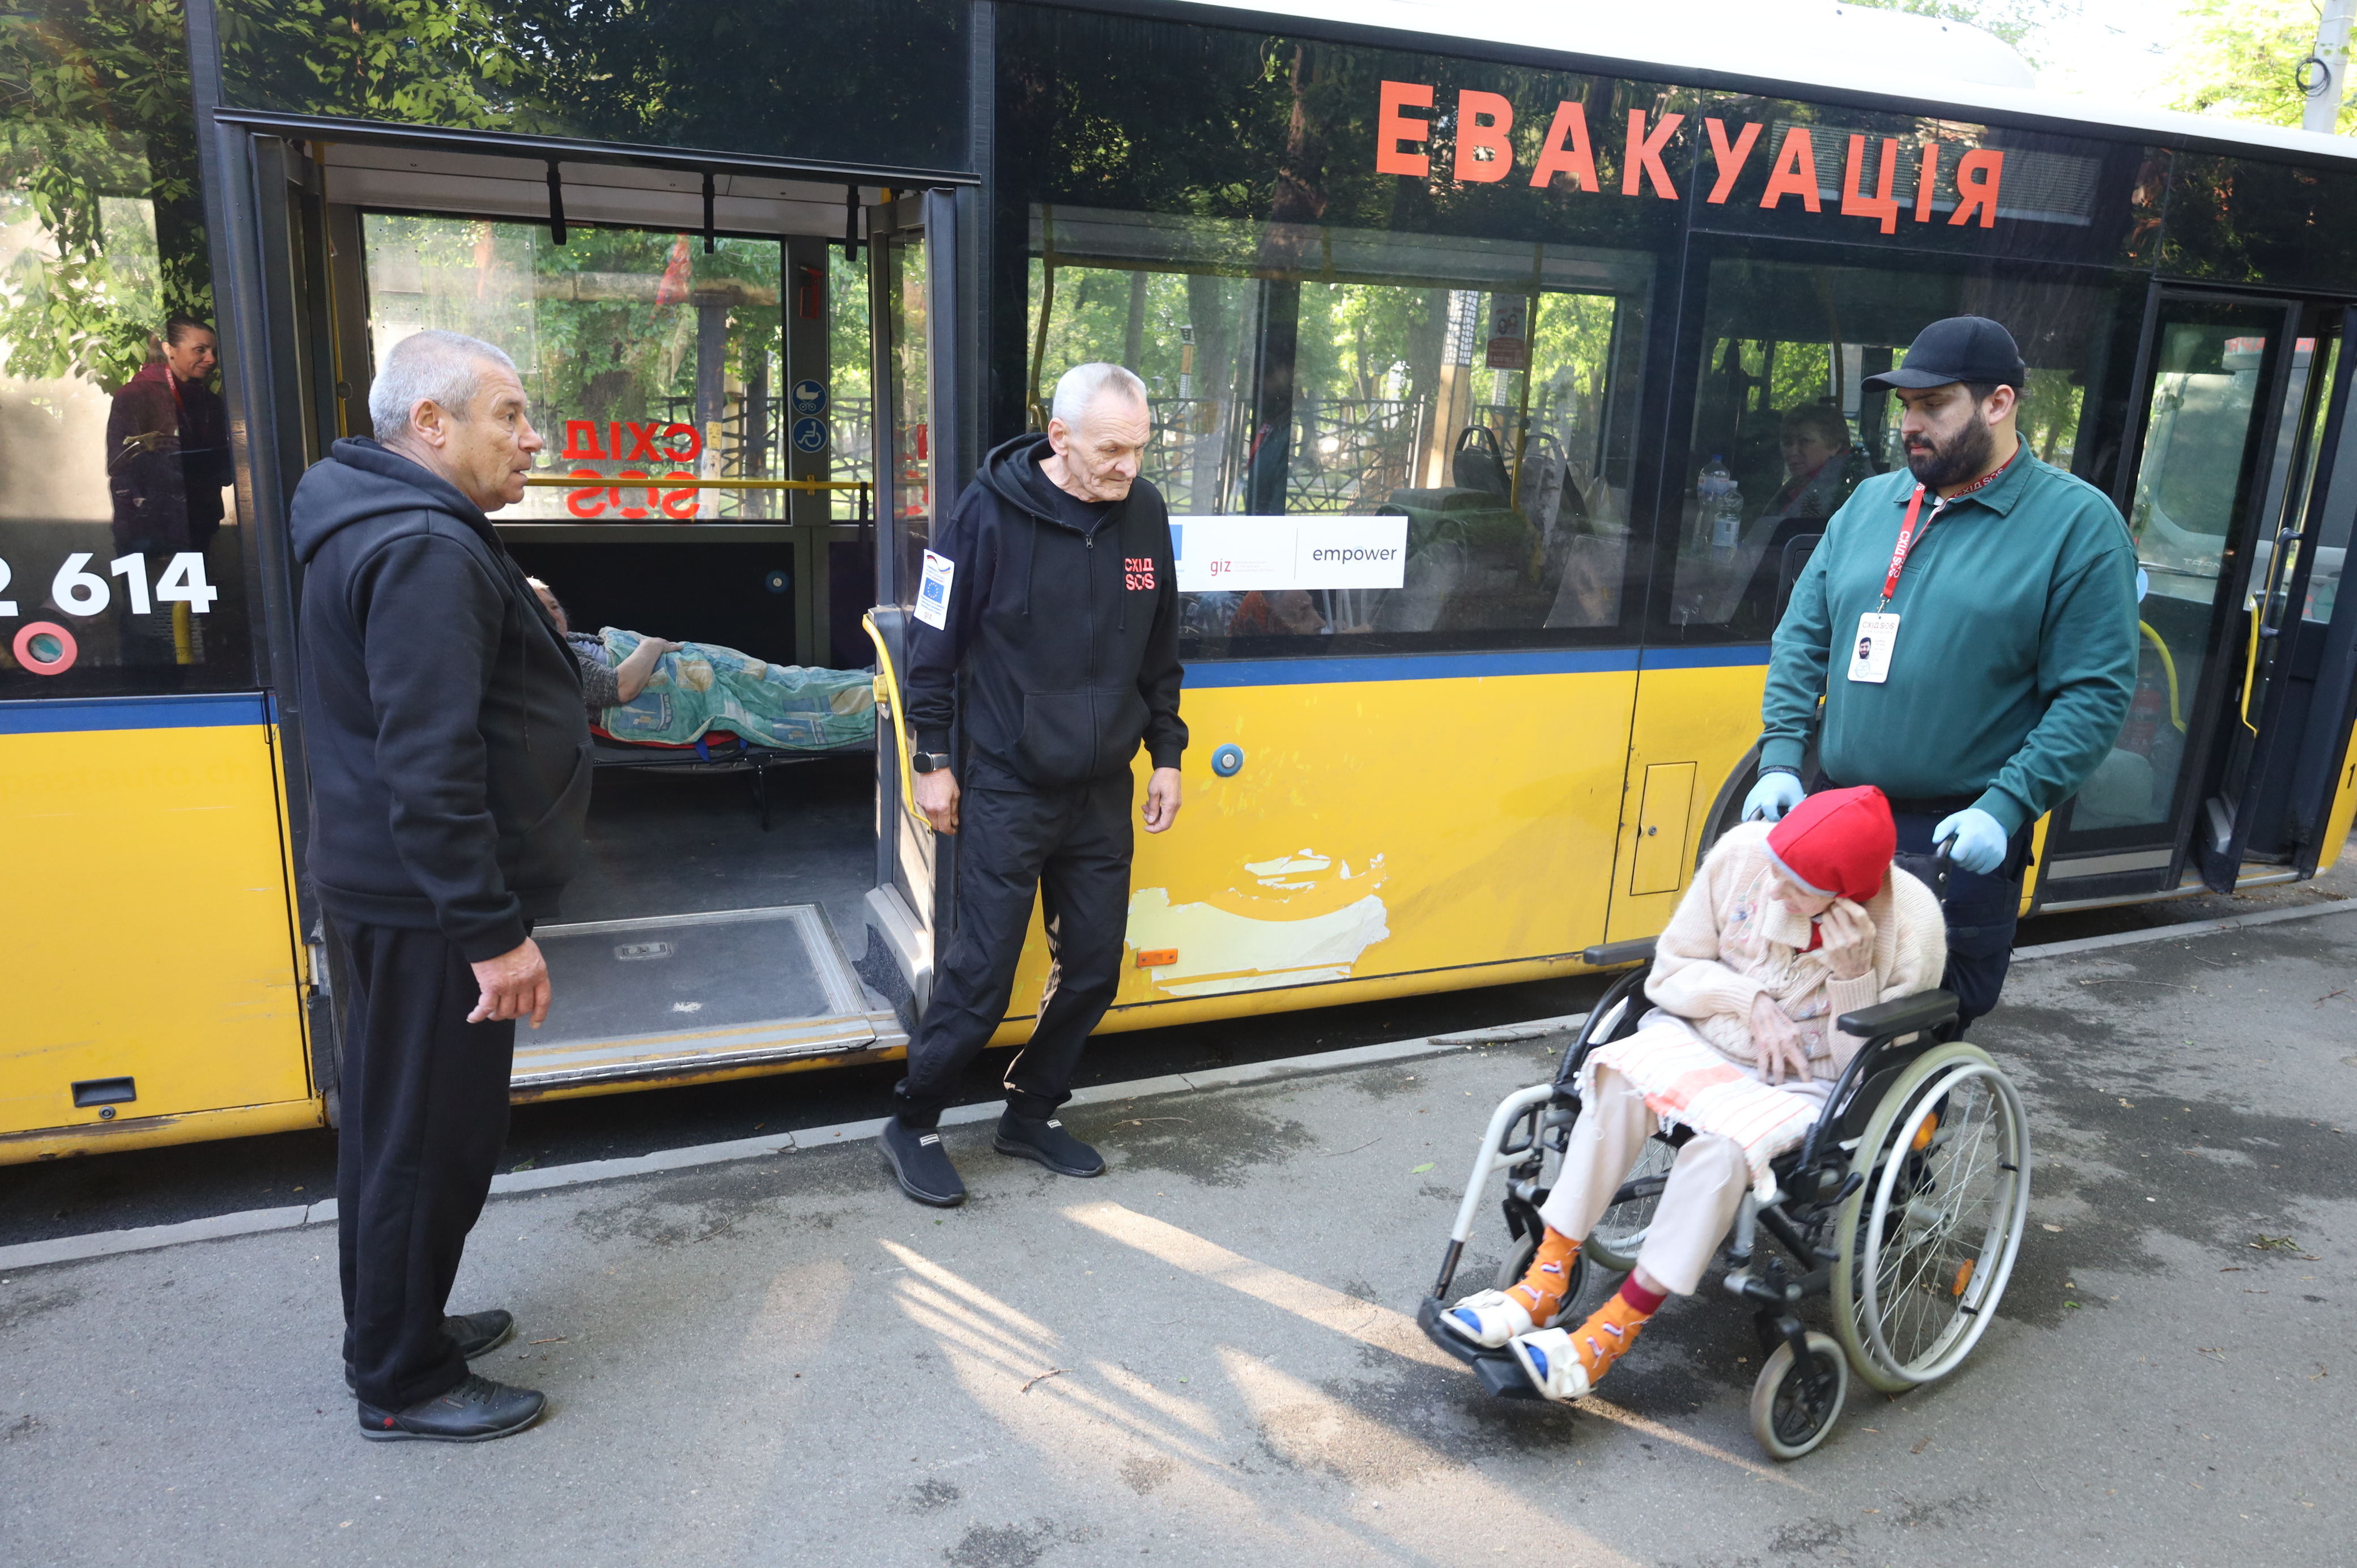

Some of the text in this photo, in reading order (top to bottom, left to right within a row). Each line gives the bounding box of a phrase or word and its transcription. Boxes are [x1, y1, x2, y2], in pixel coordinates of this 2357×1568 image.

[1377, 81, 2003, 234] ЕВАКУАЦІЯ
[1894, 531, 1911, 556] СХІД
[1125, 557, 1155, 572] СХІД
[1313, 548, 1397, 565] empower
[1210, 559, 1231, 577] giz
[52, 552, 218, 616] 614
[1125, 573, 1155, 591] SOS
